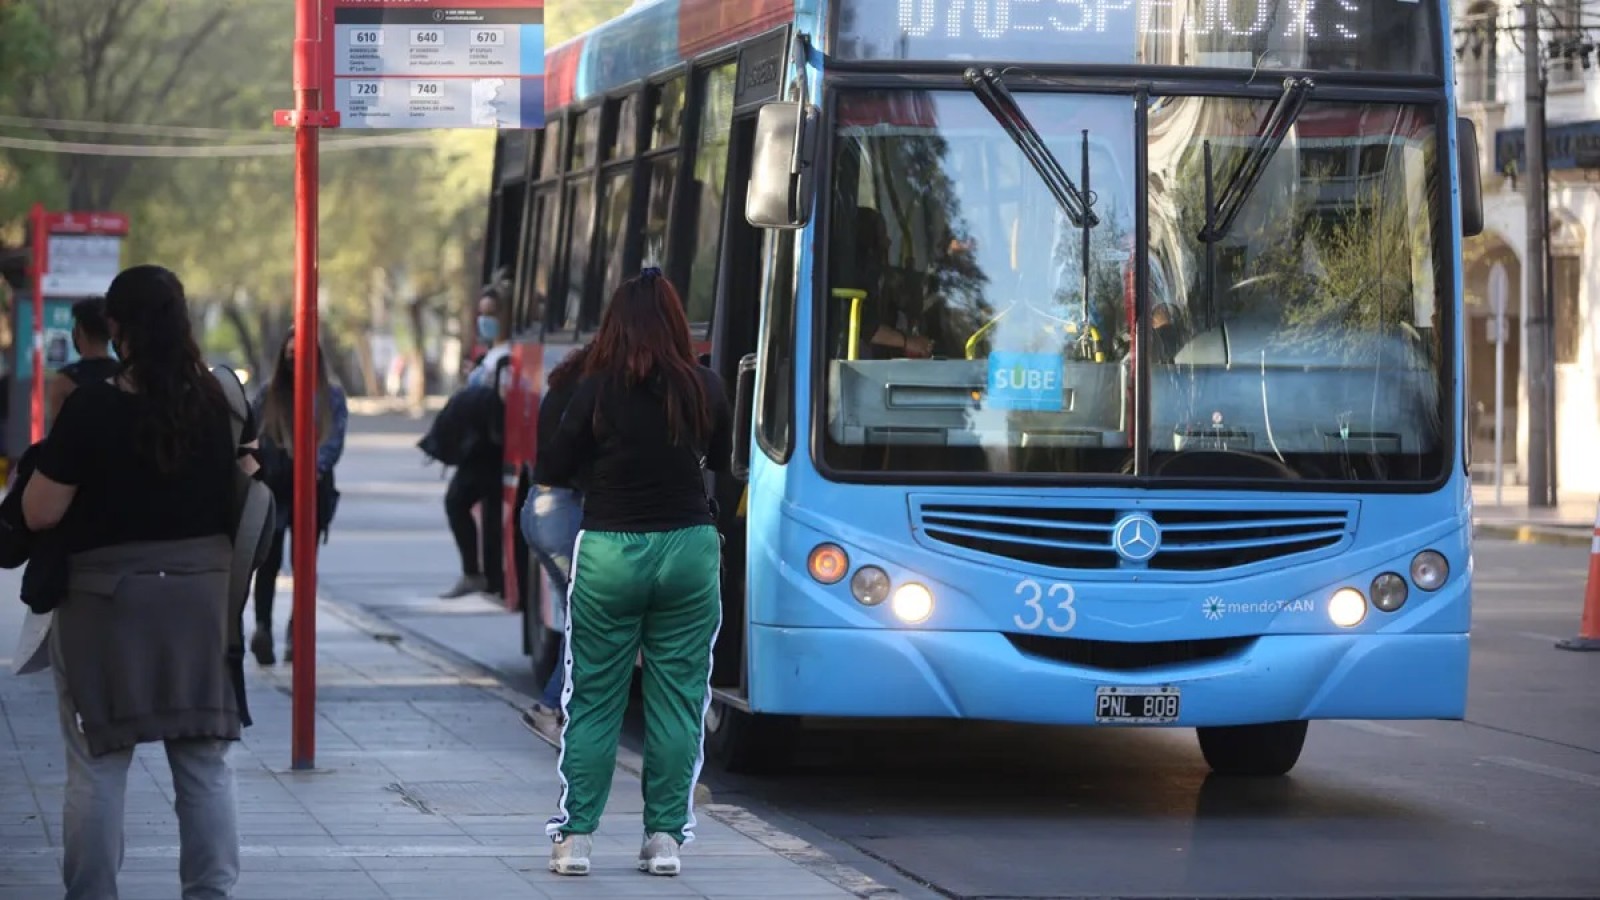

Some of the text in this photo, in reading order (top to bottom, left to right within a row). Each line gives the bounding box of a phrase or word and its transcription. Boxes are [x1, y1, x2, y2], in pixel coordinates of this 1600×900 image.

[356, 32, 377, 42] 610
[416, 32, 438, 42] 640
[476, 32, 497, 42] 670
[357, 83, 377, 94] 720
[417, 83, 437, 94] 740
[994, 367, 1057, 390] SUBE
[1012, 579, 1077, 633] 33
[1098, 696, 1177, 717] PNL 808
